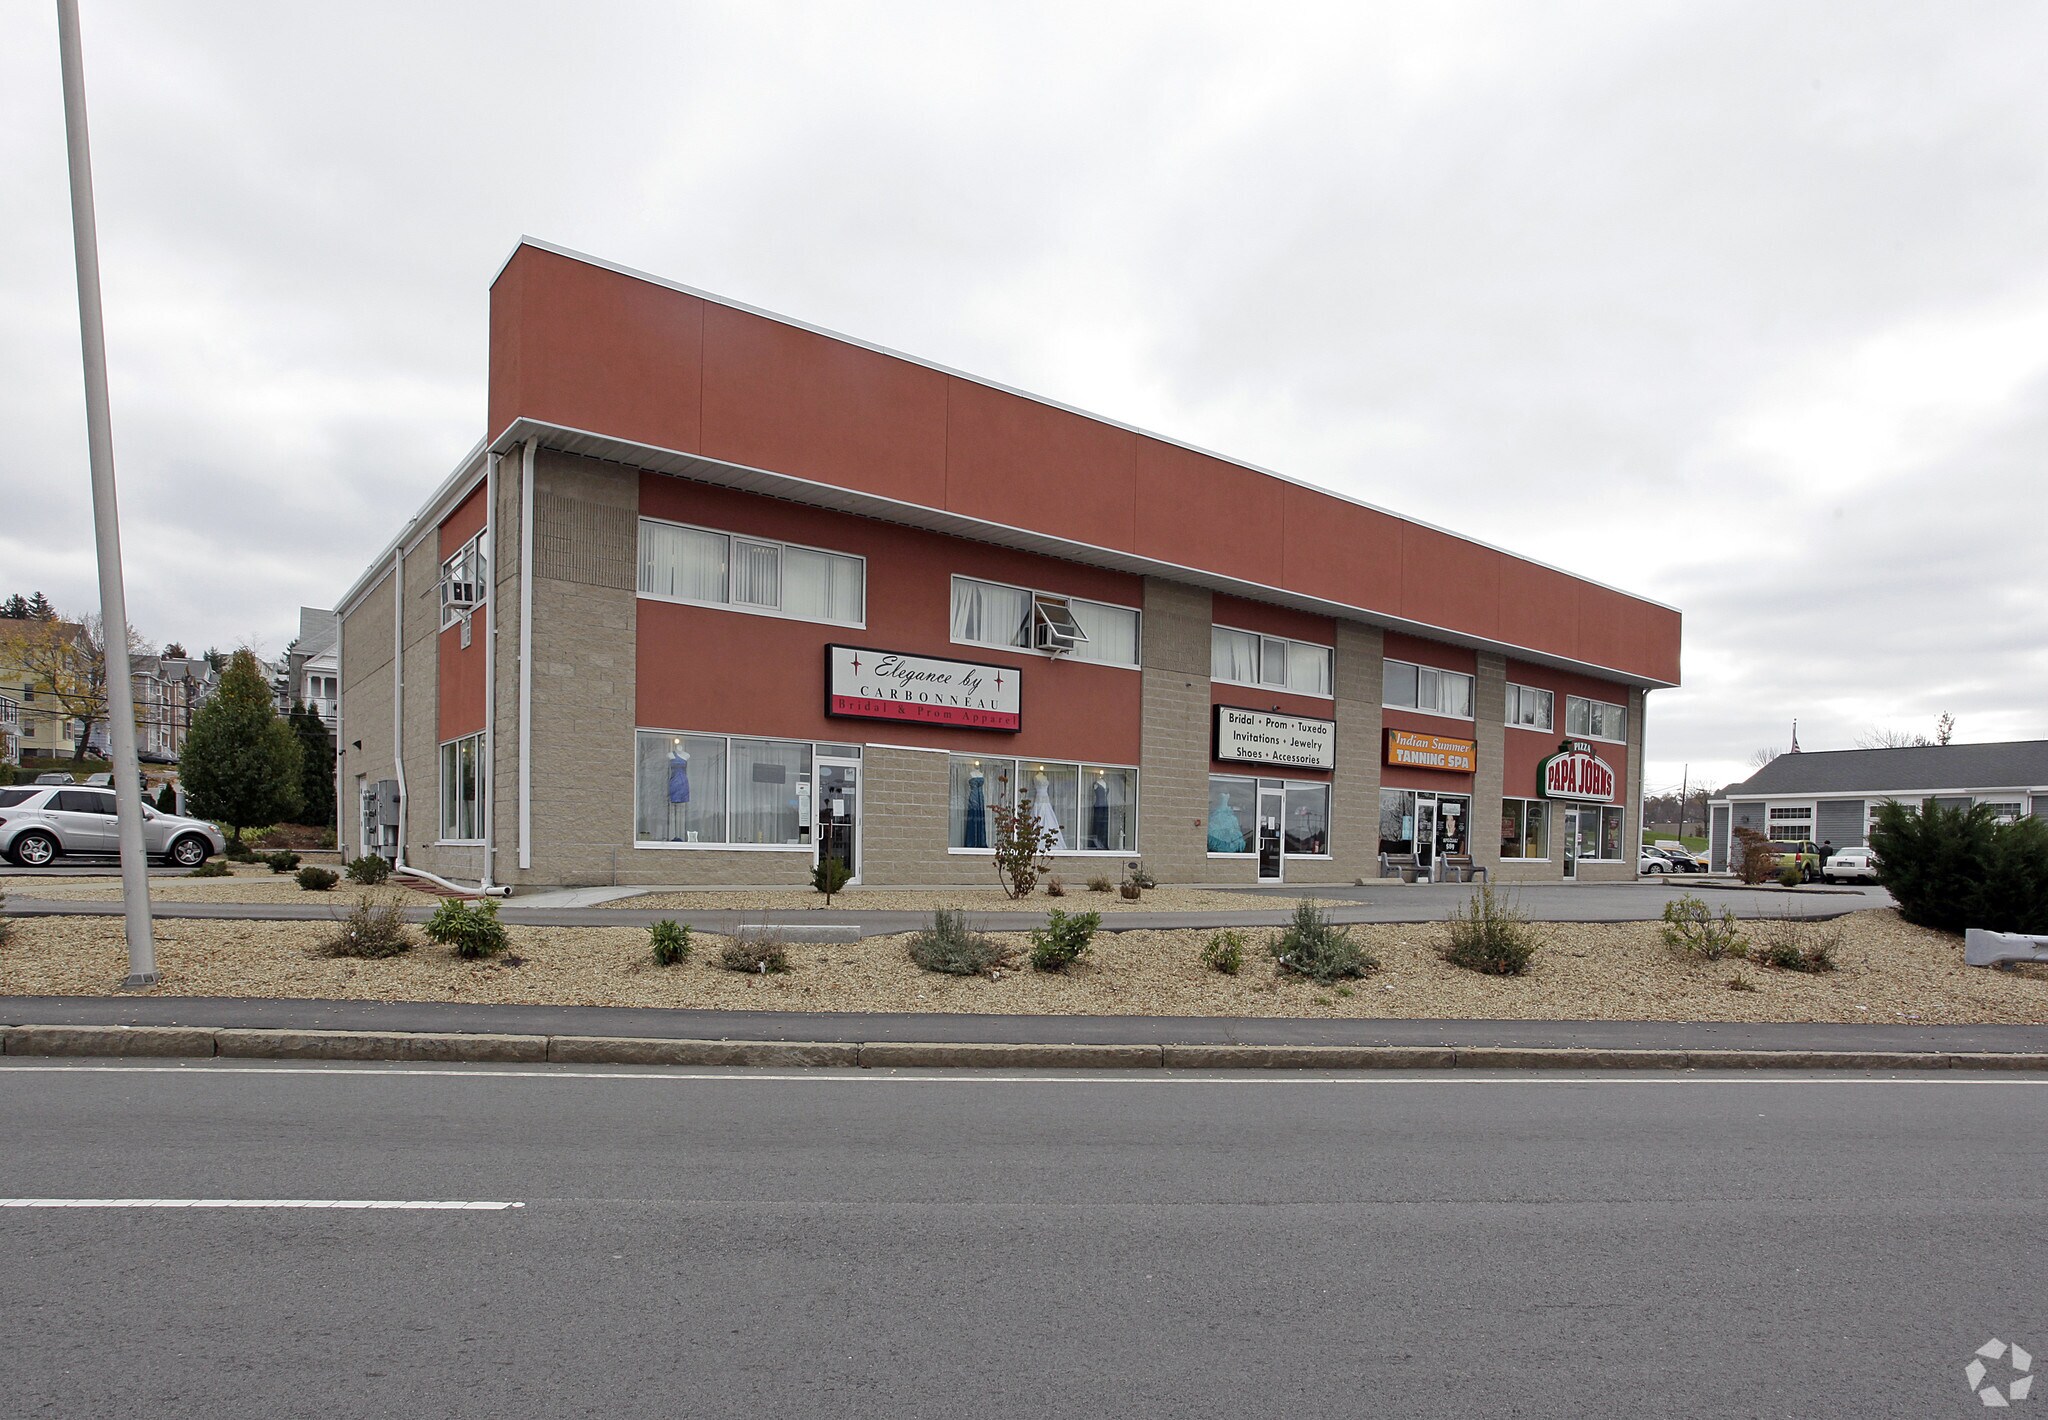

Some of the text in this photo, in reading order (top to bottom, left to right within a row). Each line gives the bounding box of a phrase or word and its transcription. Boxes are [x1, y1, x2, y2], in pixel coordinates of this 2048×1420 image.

[874, 655, 983, 695] Elegance by
[860, 685, 1000, 710] CARBONNEAU
[838, 699, 1016, 725] Bridal & Prom Apparel
[1228, 712, 1327, 735] Bridal Prom Tuxedo
[1233, 730, 1322, 752] Invitations Jewelry
[1396, 733, 1470, 753] Indian Summer
[1573, 742, 1591, 753] PIZZA
[1236, 747, 1320, 765] Shoes Accessories
[1396, 749, 1469, 769] TANNING SPA
[1548, 758, 1577, 793] PAPA
